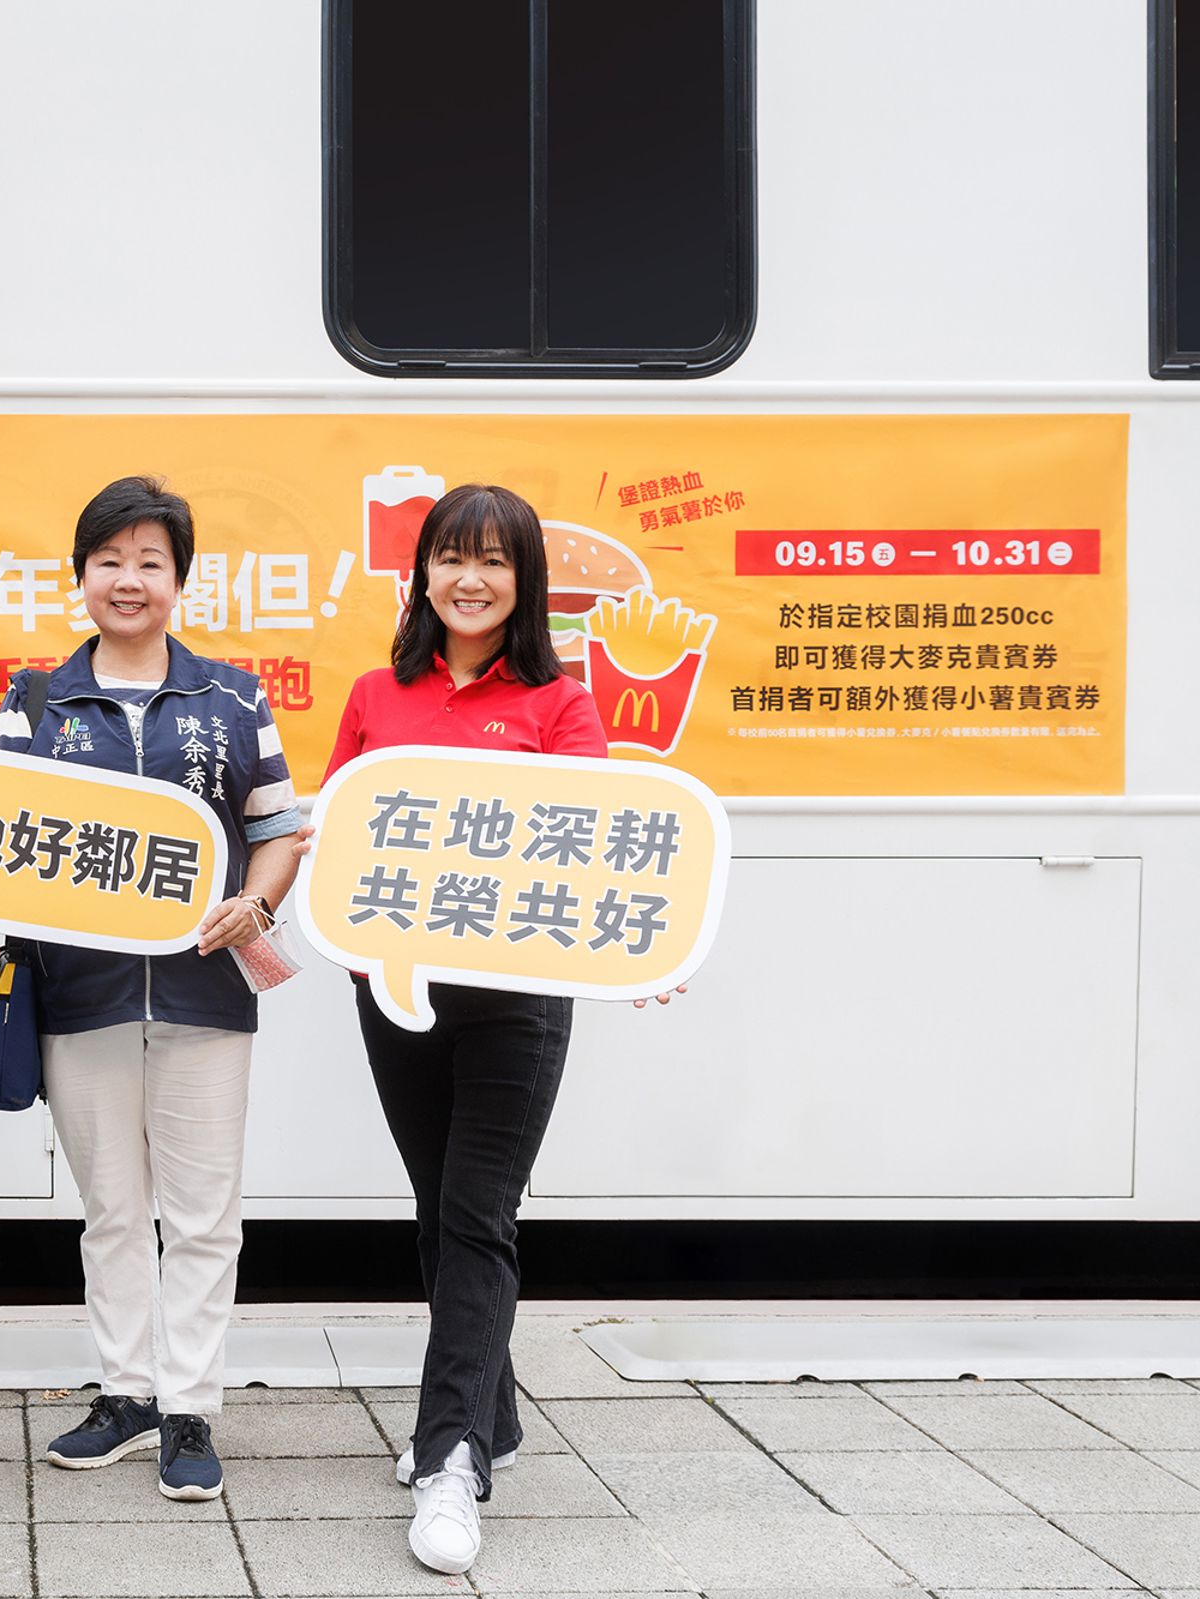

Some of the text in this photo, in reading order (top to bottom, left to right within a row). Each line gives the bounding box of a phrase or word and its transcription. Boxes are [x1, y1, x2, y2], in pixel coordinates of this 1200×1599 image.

[618, 471, 704, 508] 堡證熱血
[639, 490, 746, 533] 勇氣薯於你
[779, 603, 1054, 629] 於指定校園捐血250cc
[775, 644, 1058, 670] 即可獲得大麥克貴賓券
[730, 684, 1100, 712] 首捐者可額外獲得小薯貴賓券
[51, 740, 95, 759] 中正區
[210, 715, 230, 800] 文北里里長
[367, 790, 681, 877] 在地深耕
[347, 866, 671, 956] 共榮共好
